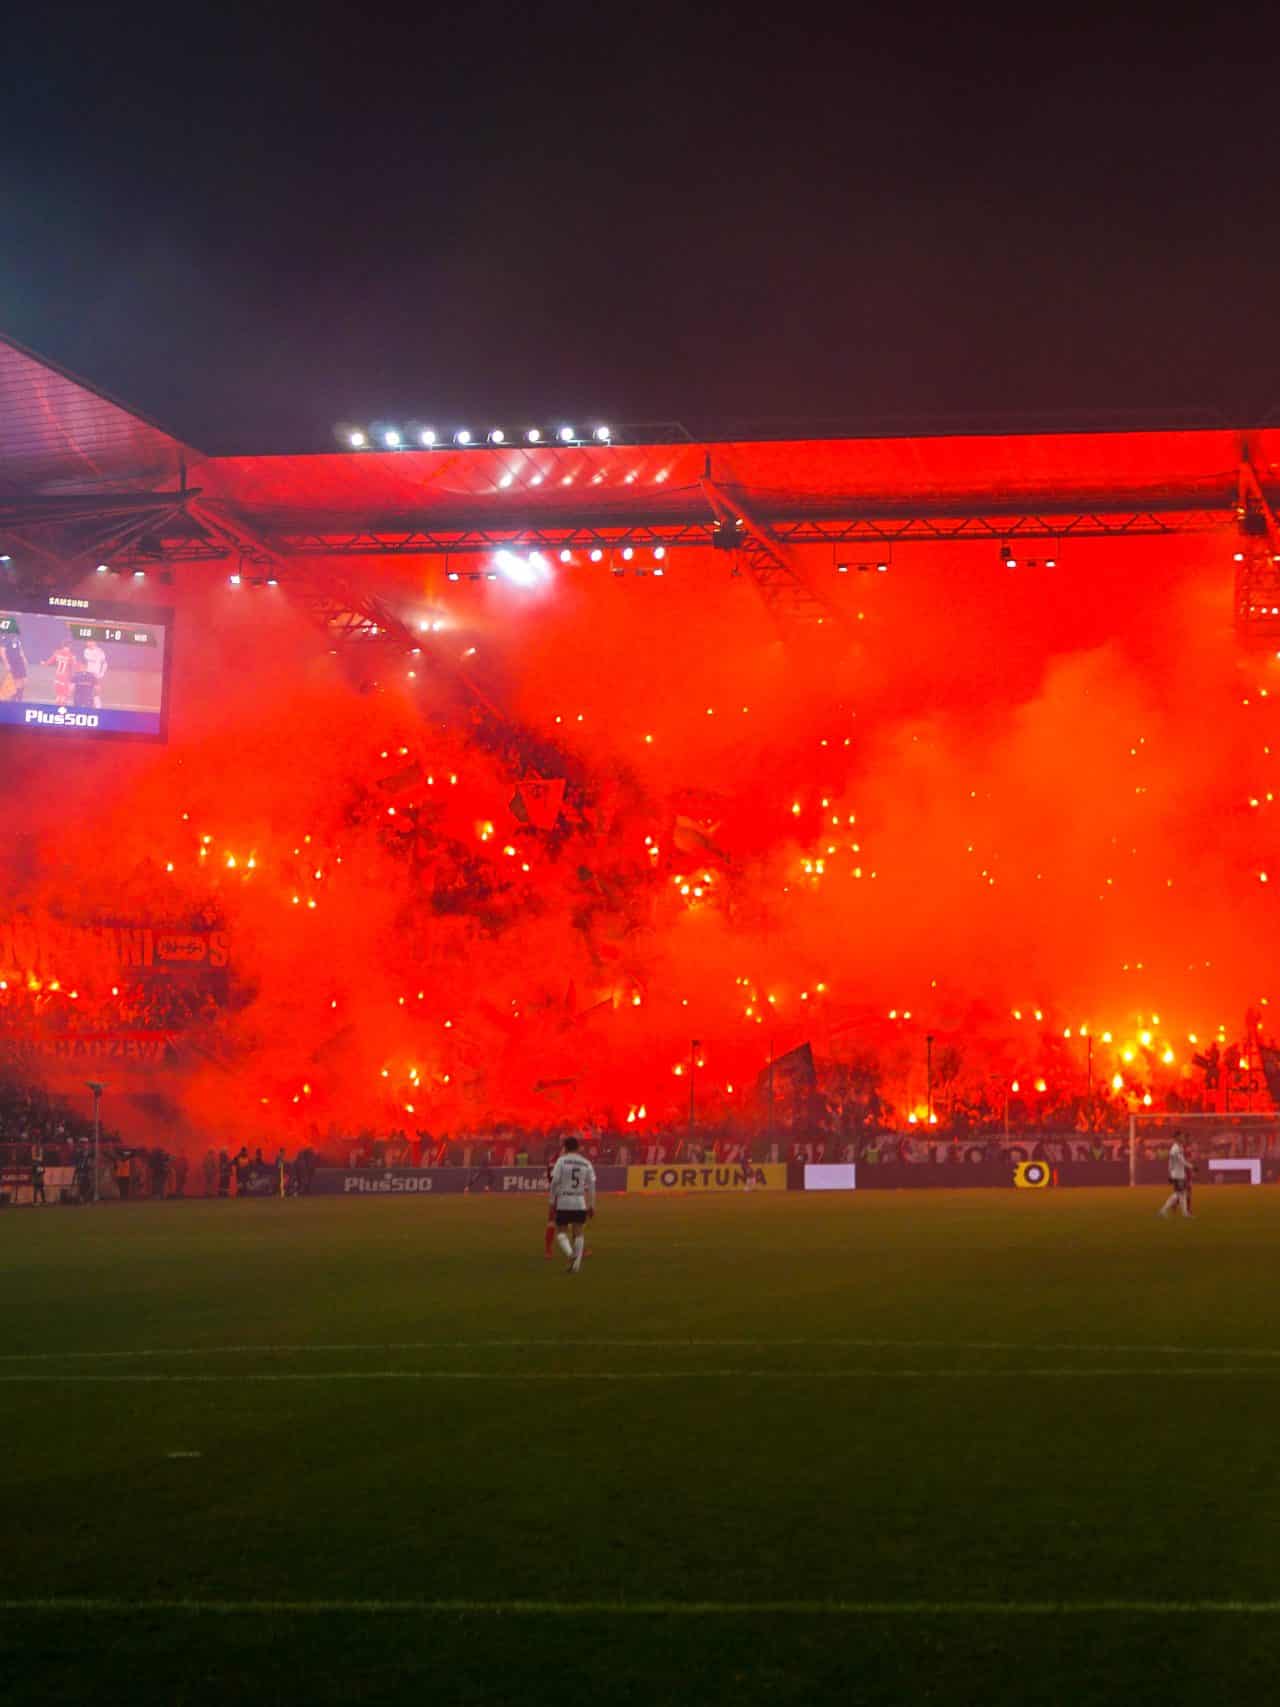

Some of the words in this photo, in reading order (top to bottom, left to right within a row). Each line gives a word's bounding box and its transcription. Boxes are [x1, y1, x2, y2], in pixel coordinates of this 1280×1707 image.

[49, 597, 89, 608] SAMSUNG
[25, 706, 99, 727] Plus500
[344, 1172, 432, 1192] Plus500
[571, 1167, 581, 1189] 5
[643, 1168, 767, 1187] FORTUNA
